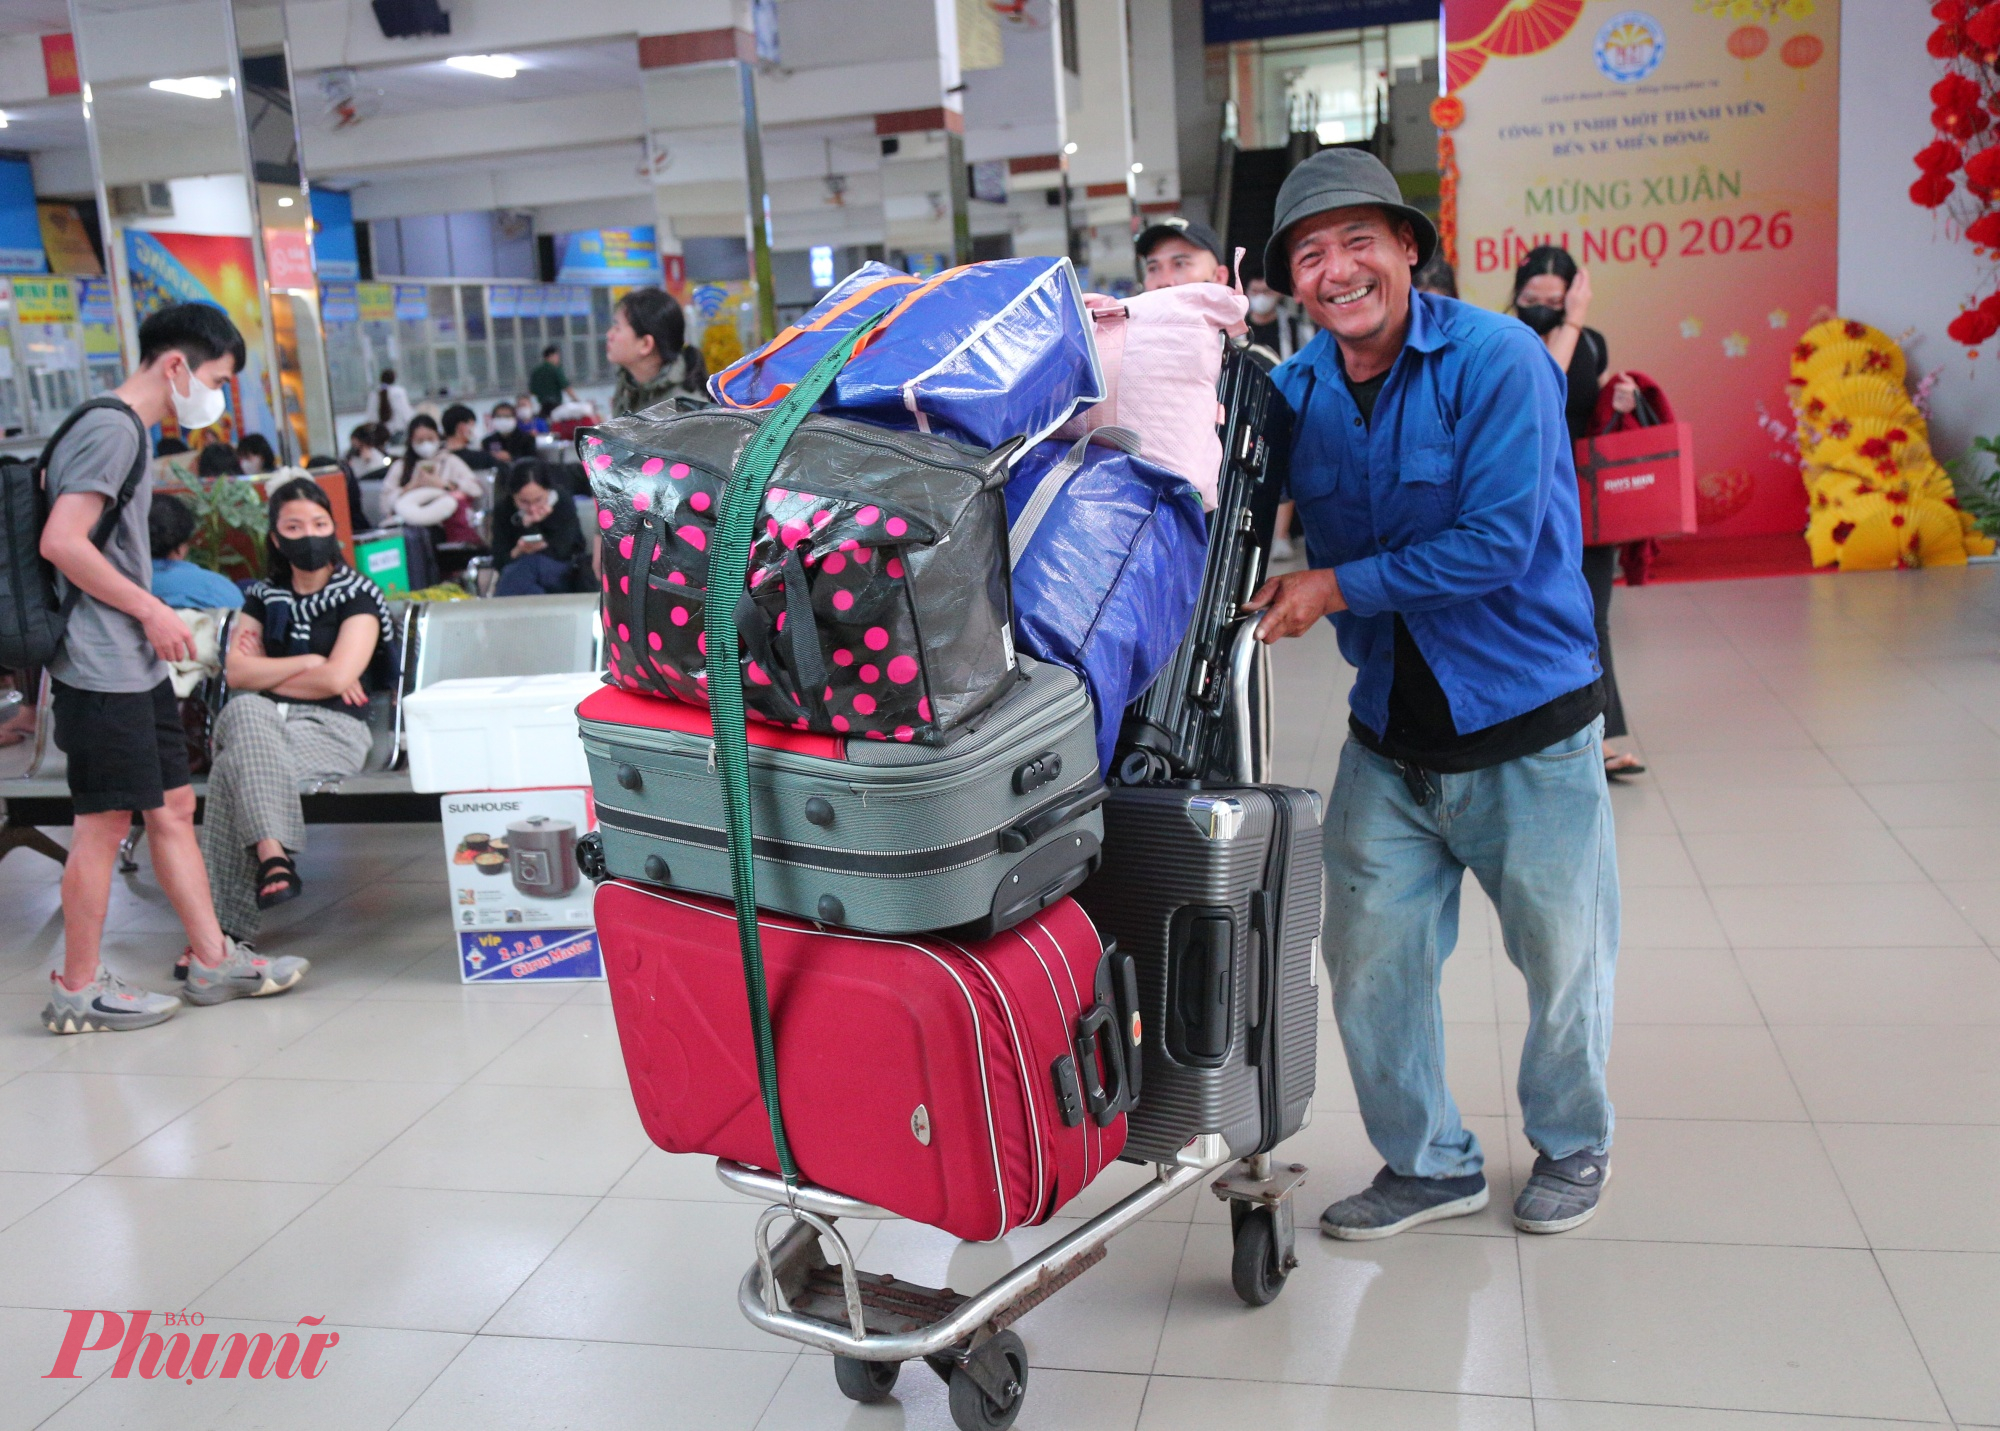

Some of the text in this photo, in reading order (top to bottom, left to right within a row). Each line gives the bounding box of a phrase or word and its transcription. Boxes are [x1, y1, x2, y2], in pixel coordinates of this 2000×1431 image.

[1524, 164, 1742, 217] MỪNG XUÂN
[1582, 221, 1669, 269] NGỌ
[1680, 210, 1794, 257] 2026
[448, 801, 521, 814] SUNHOUSE
[511, 939, 593, 977] Citrus Master
